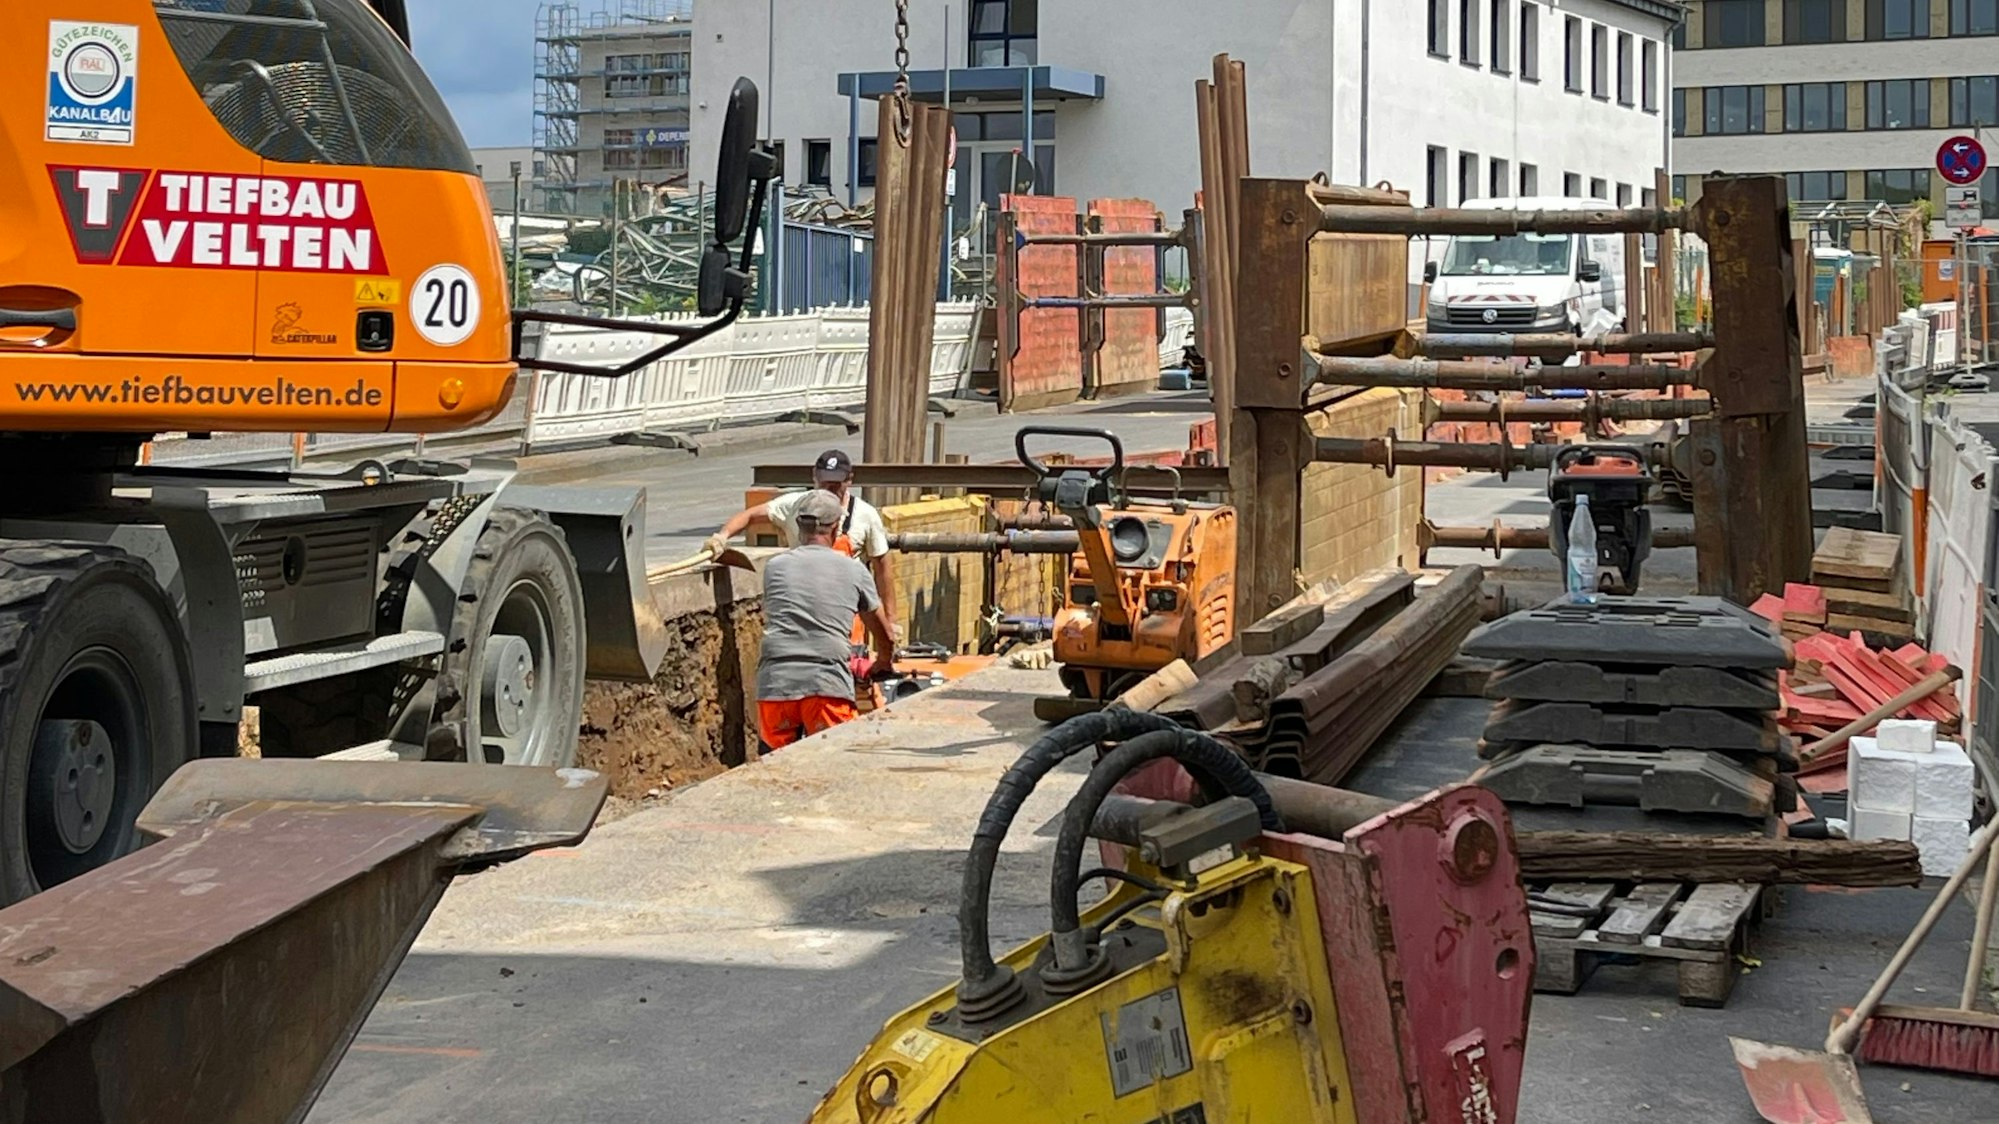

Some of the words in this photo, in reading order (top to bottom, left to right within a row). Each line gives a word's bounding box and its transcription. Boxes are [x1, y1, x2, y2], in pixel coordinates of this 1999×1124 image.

[52, 26, 134, 62] GÜTEZEICHEN
[49, 106, 131, 123] KANALBAU
[80, 130, 100, 139] AK2
[160, 174, 356, 219] TIEFBAU
[142, 219, 371, 270] VELTEN
[425, 278, 468, 328] 20
[15, 376, 382, 406] www.tiefbauvelten.de
